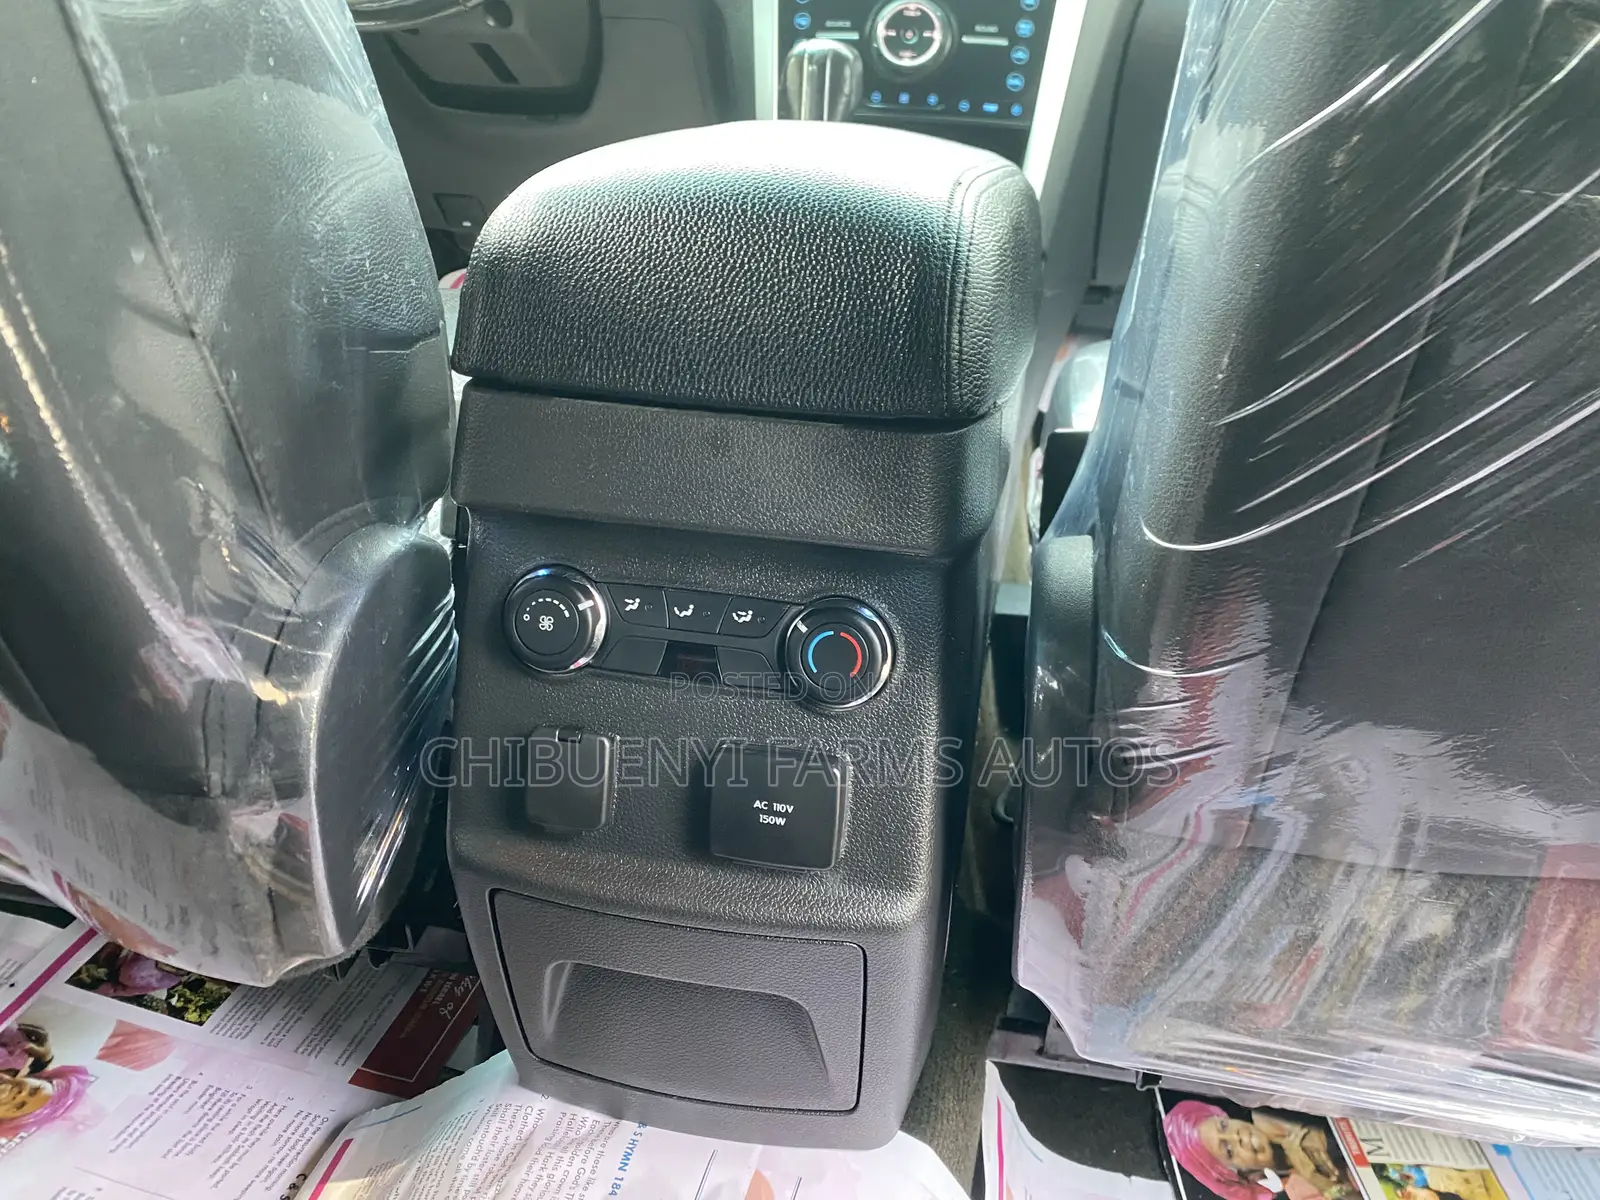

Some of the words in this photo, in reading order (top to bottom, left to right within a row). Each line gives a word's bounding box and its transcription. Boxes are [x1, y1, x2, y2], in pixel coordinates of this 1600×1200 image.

[753, 799, 769, 810] AC
[773, 802, 794, 814] 110V
[759, 814, 786, 826] 150W
[272, 1104, 286, 1117] Here
[293, 1109, 304, 1118] No
[301, 1112, 312, 1120] No
[490, 1102, 502, 1117] Still
[497, 1102, 512, 1124] Shall
[505, 1104, 522, 1131] These,
[281, 1119, 295, 1133] more
[308, 1113, 321, 1127] Soul
[317, 1116, 329, 1126] On
[515, 1105, 533, 1140] Clothed
[531, 1108, 545, 1129] Who
[544, 1111, 566, 1141] Praising
[574, 1116, 589, 1135] Who
[290, 1121, 303, 1135] more
[298, 1126, 309, 1138] and
[311, 1126, 321, 1135] the
[489, 1126, 502, 1147] their
[287, 1138, 302, 1152] body
[459, 1137, 474, 1160] come
[470, 1119, 491, 1161] untouch'd
[493, 1135, 510, 1161] whose
[599, 1135, 610, 1148] are
[286, 1136, 312, 1167] resurrection
[580, 1138, 596, 1164] before
[617, 1138, 638, 1171] HYMN
[266, 1156, 275, 1164] no
[454, 1162, 462, 1174] all
[463, 1162, 475, 1172] by
[478, 1149, 494, 1171] luster
[524, 1157, 538, 1176] their
[538, 1151, 554, 1172] Hark
[551, 1155, 564, 1171] this
[589, 1150, 604, 1175] these
[254, 1164, 268, 1178] more
[568, 1166, 586, 1190] God's
[468, 1173, 479, 1187] still
[527, 1173, 543, 1192] they
[554, 1169, 569, 1194] crown
[581, 1176, 596, 1191] like
[608, 1176, 623, 1195] 184
